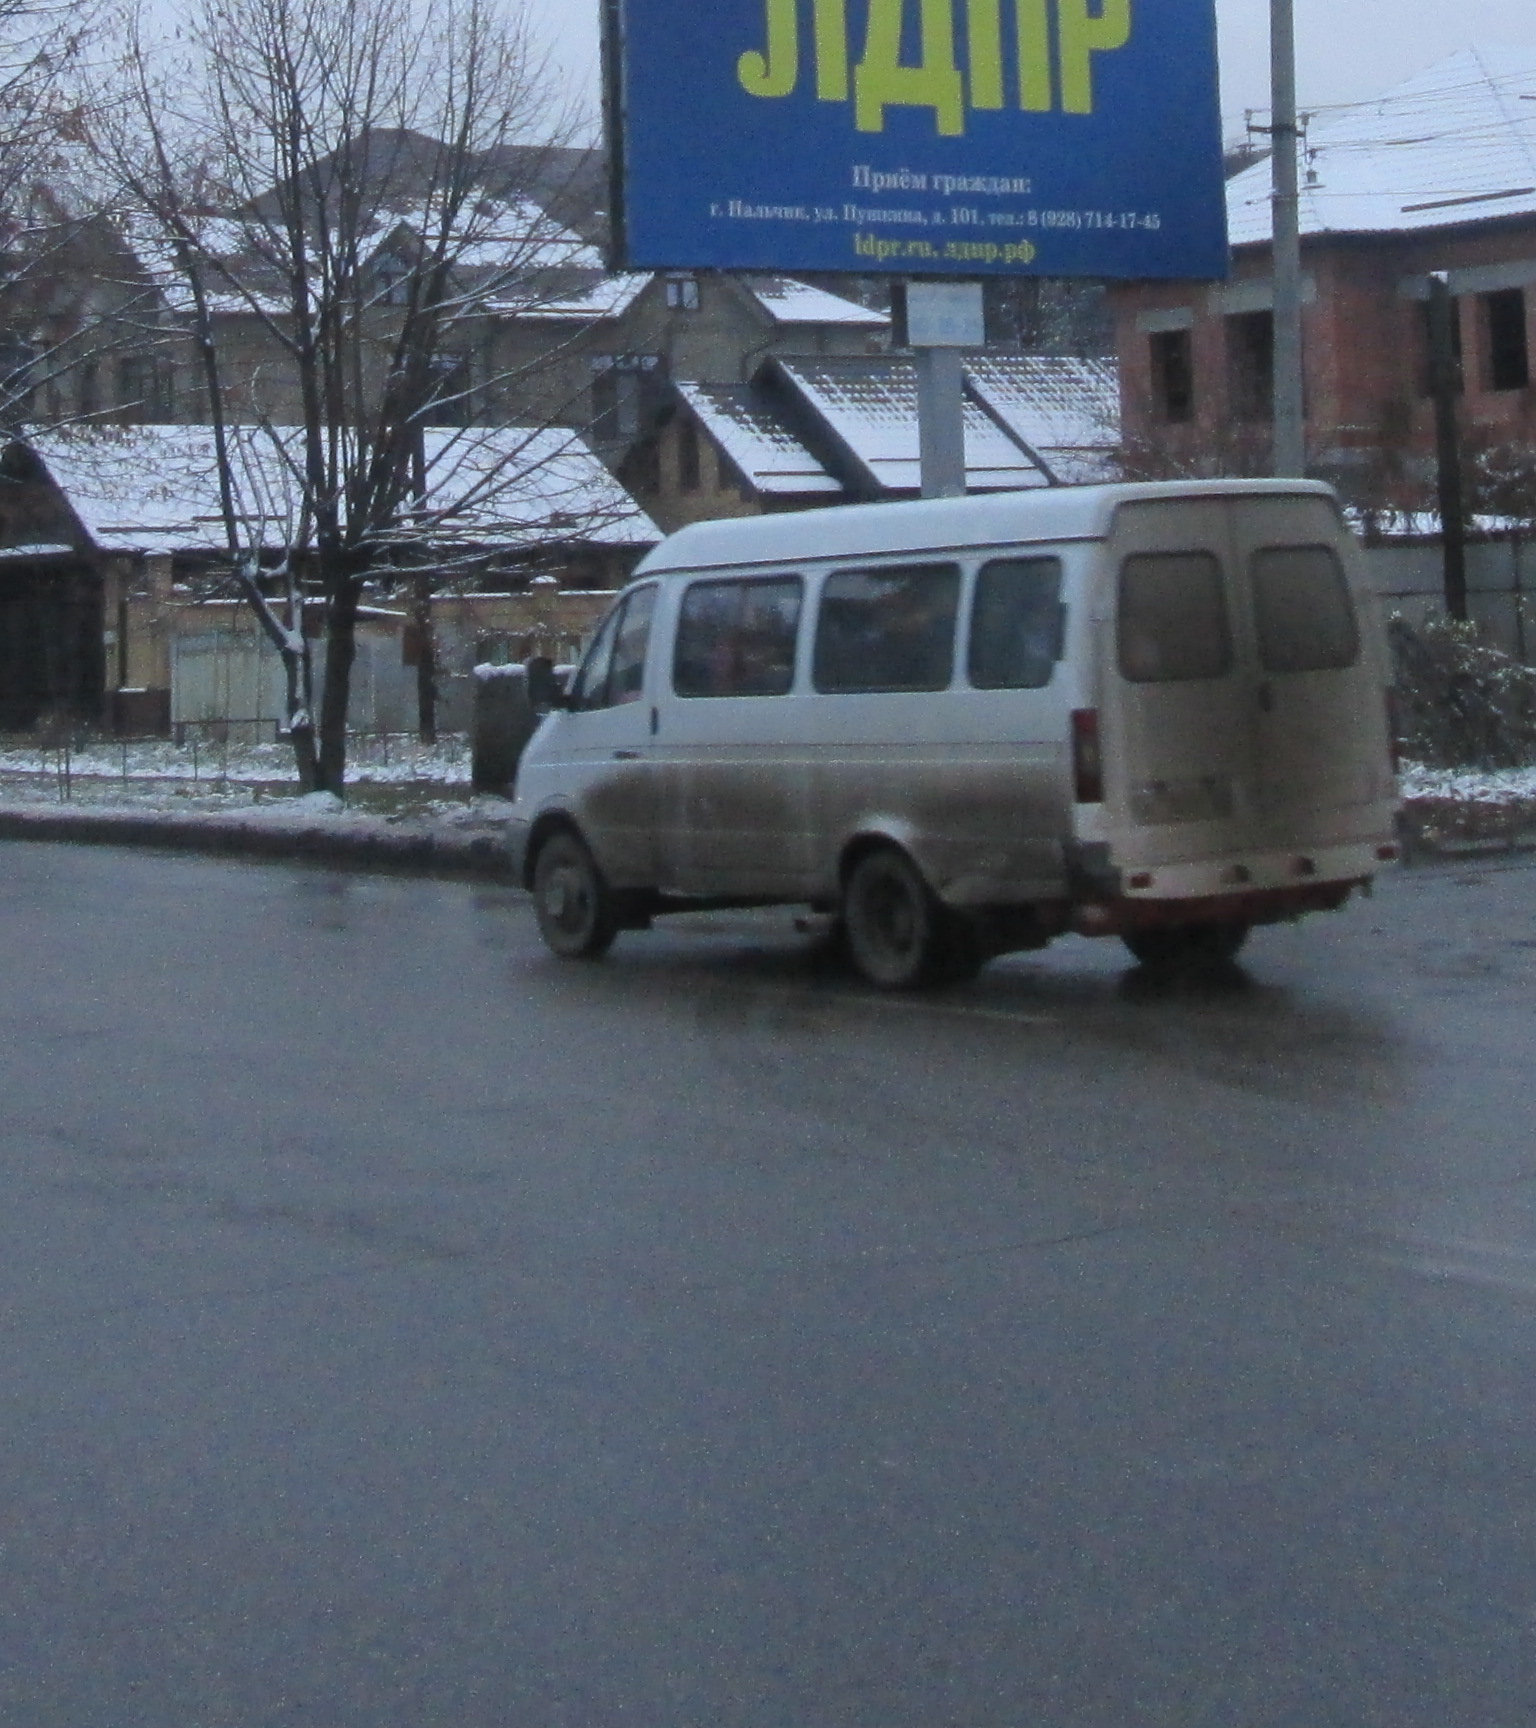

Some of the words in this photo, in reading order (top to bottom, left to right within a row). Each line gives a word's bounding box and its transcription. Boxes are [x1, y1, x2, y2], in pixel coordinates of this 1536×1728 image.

[852, 165, 928, 194] Приём
[932, 175, 1031, 195] граждан:
[710, 202, 724, 218] г.
[813, 207, 838, 222] ул.
[843, 204, 928, 226] Пушкина,
[1027, 210, 1037, 227] 8
[1041, 210, 1082, 229] (928)
[1085, 212, 1161, 231] 714-17-45
[944, 238, 1035, 263] лдпр.рф
